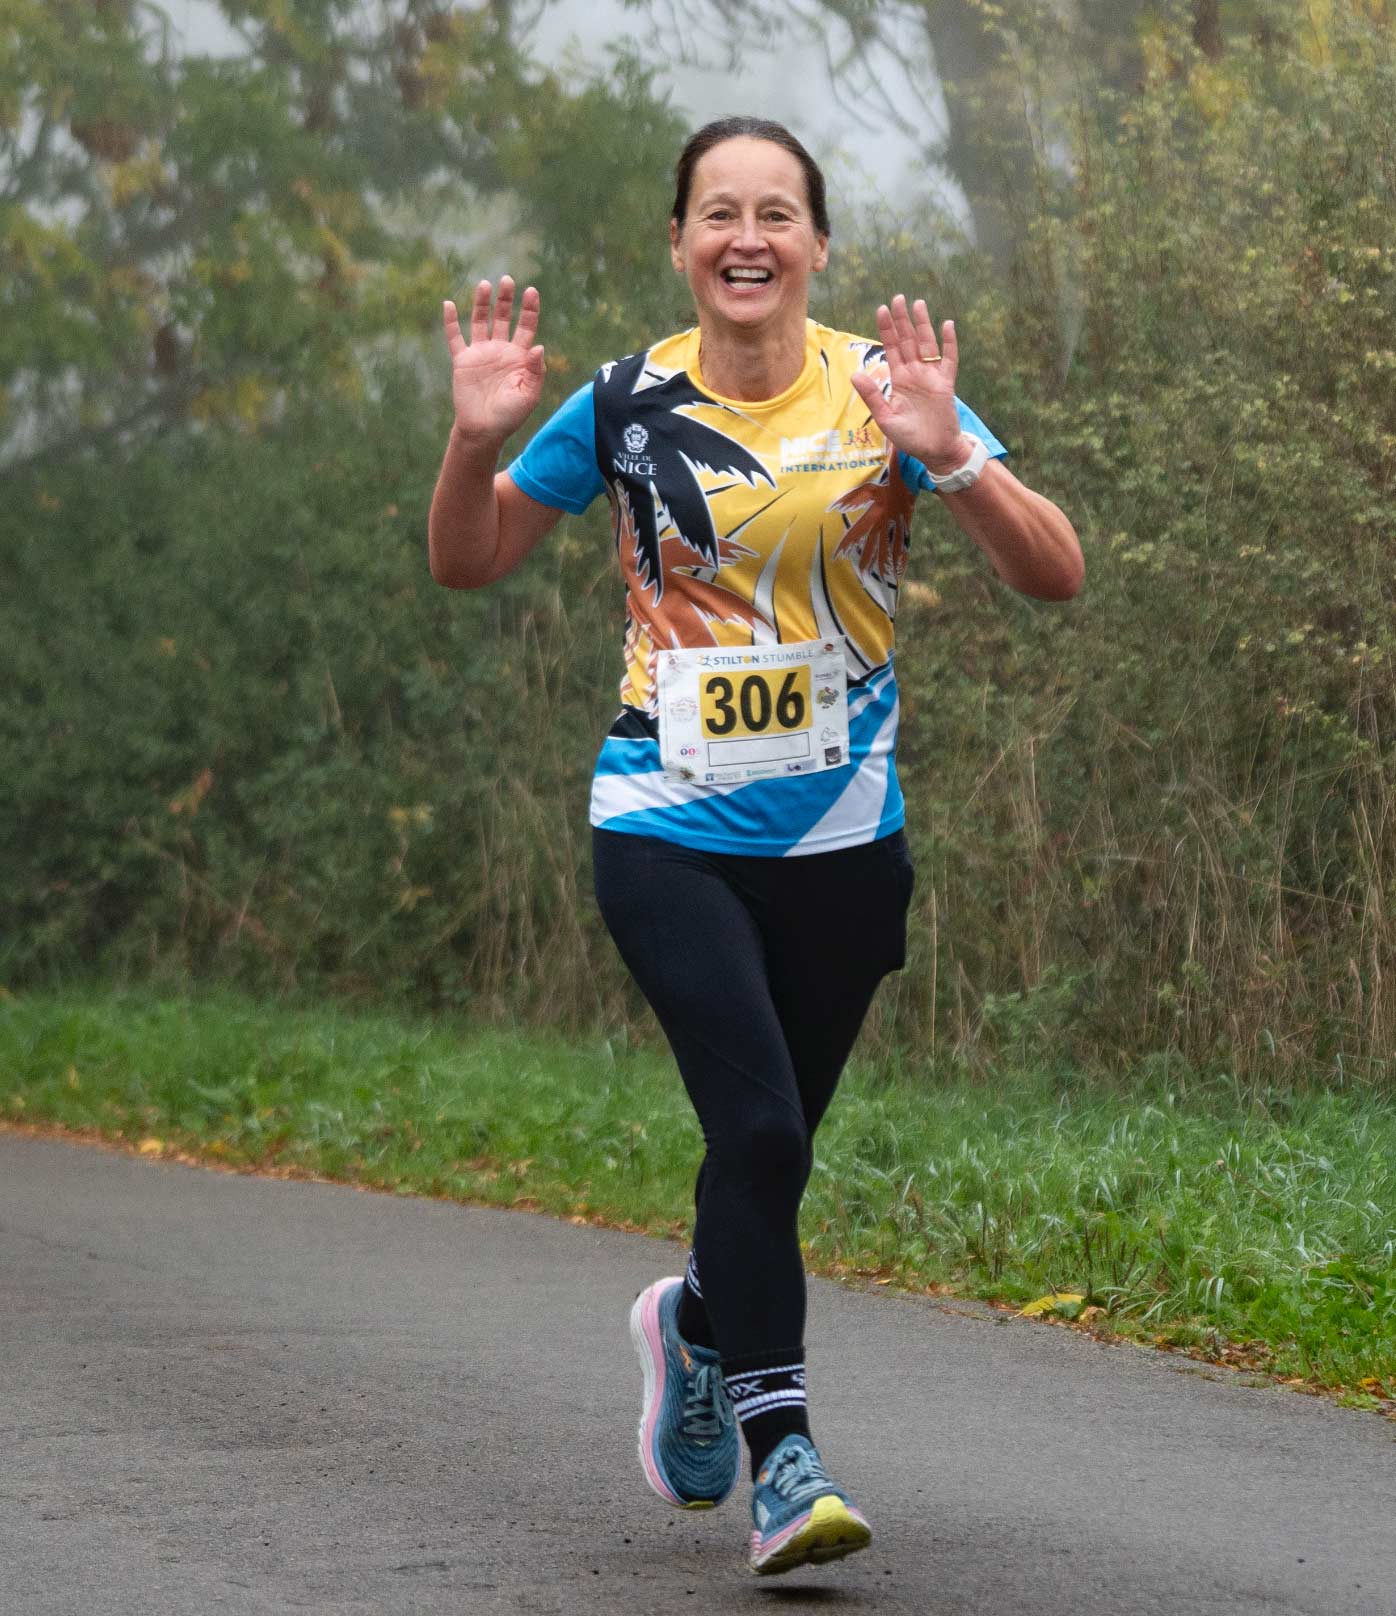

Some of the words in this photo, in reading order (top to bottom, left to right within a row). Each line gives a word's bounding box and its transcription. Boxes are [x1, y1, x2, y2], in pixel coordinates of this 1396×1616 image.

[780, 430, 842, 456] NICE
[617, 452, 639, 461] VILLE
[613, 458, 657, 475] NICE
[780, 459, 884, 473] INTERNATIONAL
[713, 655, 760, 665] STILTON
[763, 650, 814, 663] STUMBLE
[705, 672, 805, 735] 306
